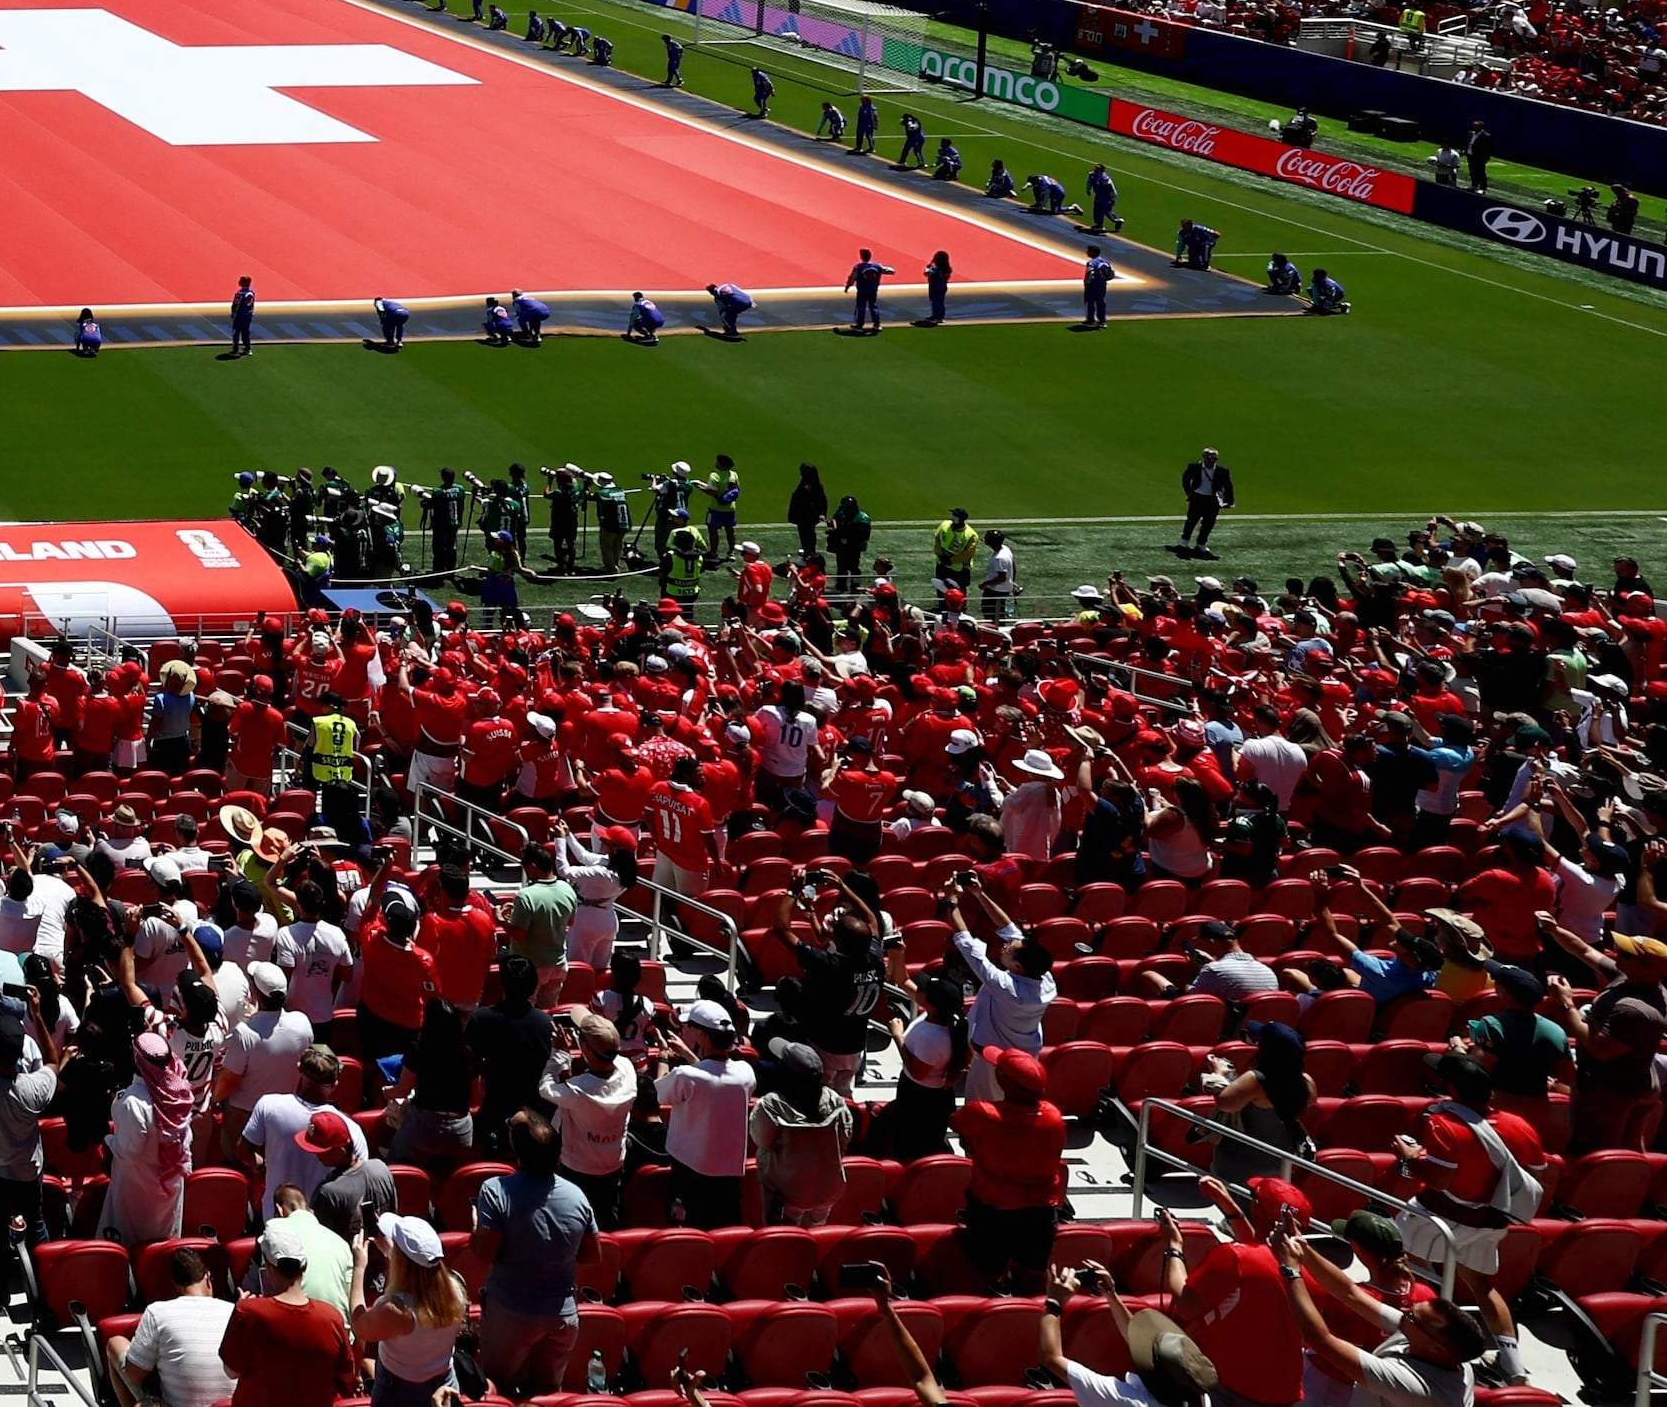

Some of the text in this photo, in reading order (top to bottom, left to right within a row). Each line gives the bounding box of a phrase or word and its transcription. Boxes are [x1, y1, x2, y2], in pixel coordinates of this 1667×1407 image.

[921, 51, 1059, 111] aramco
[1131, 109, 1221, 156] Coca-Cola
[1275, 147, 1380, 201] Coca-Cola
[302, 679, 330, 698] 20
[780, 723, 803, 748] 10
[868, 792, 883, 815] 7
[659, 808, 682, 843] 11
[844, 982, 881, 1016] 10
[184, 1050, 214, 1082] 10
